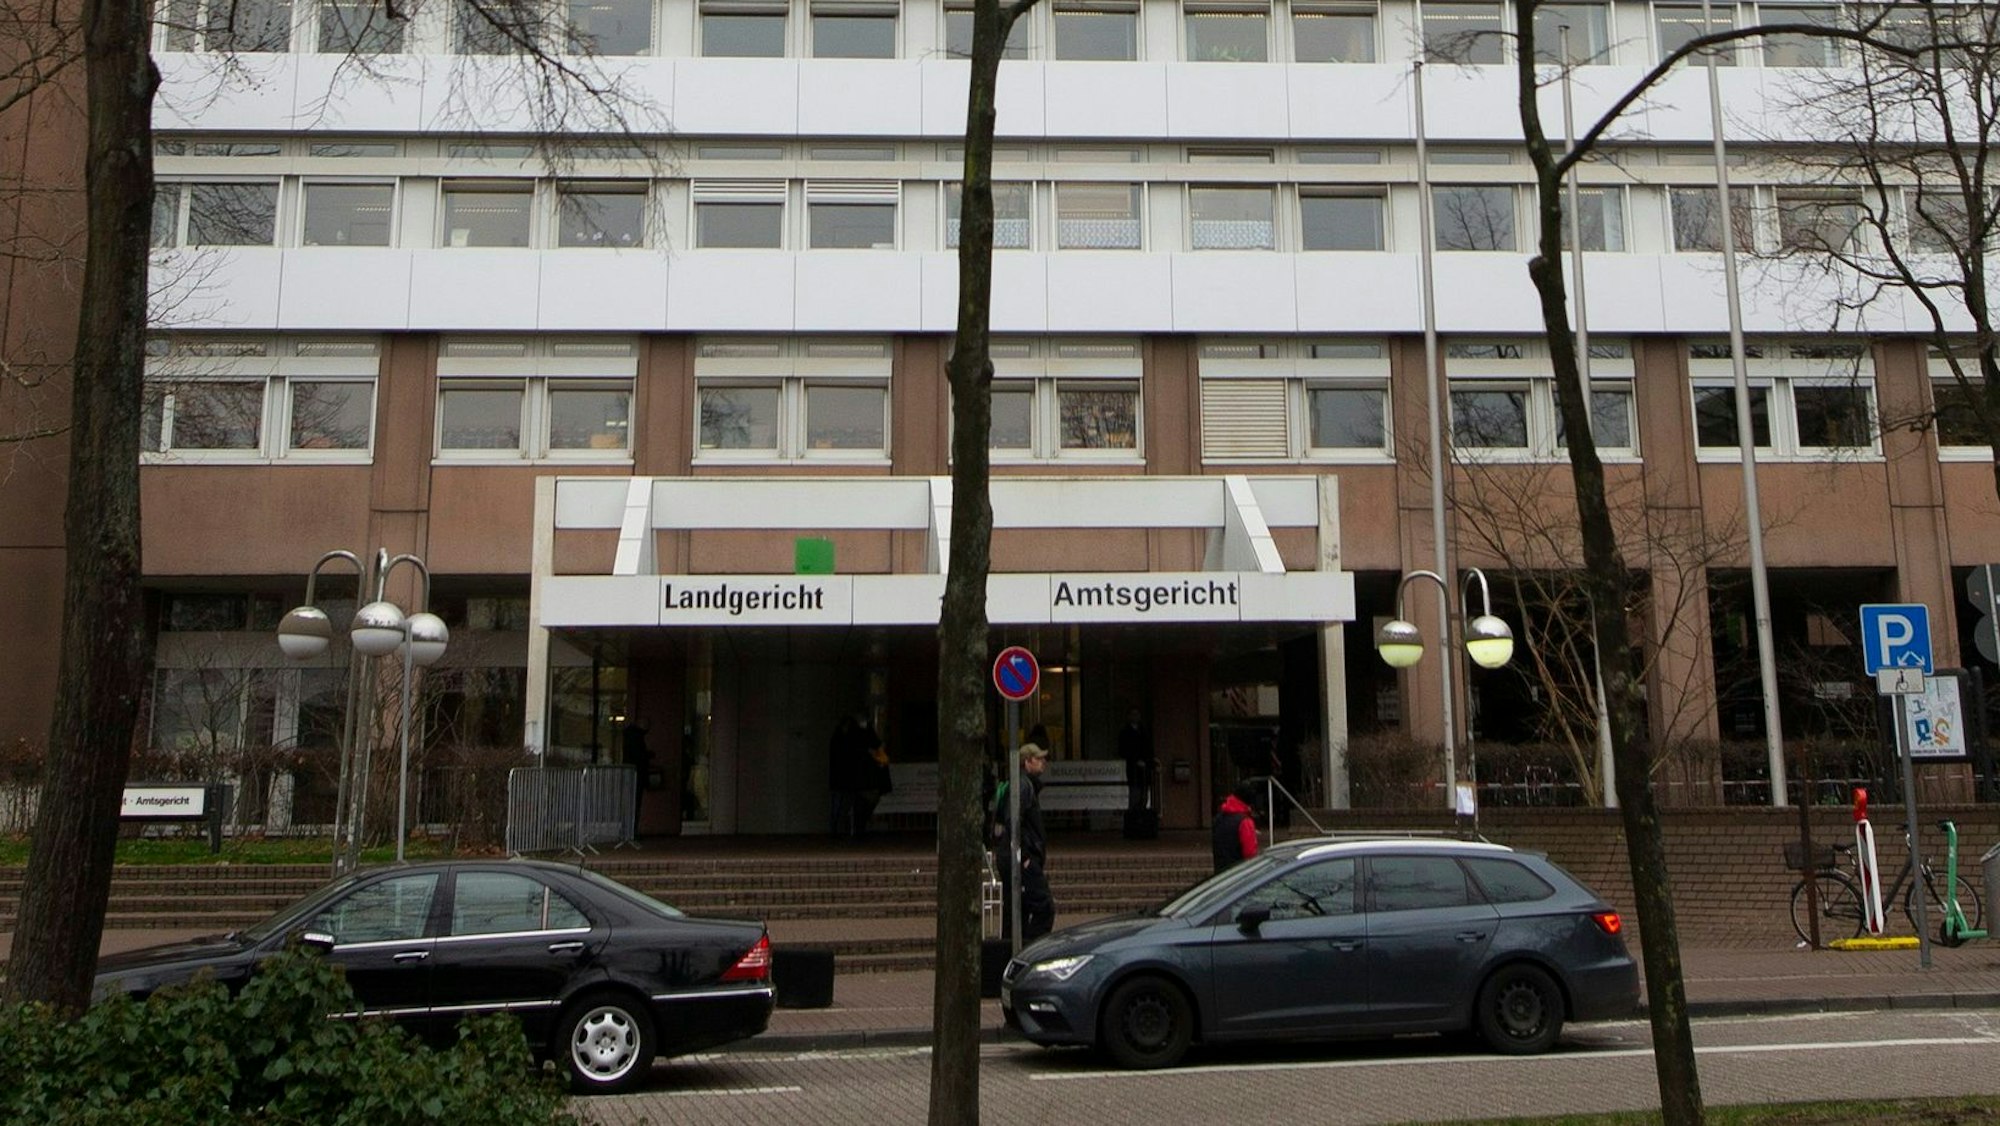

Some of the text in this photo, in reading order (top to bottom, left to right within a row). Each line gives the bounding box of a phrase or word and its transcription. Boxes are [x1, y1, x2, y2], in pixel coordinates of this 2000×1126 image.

[665, 584, 823, 615] Landgericht
[1054, 580, 1237, 612] Amtsgericht
[1878, 614, 1914, 665] P
[136, 796, 190, 807] Amtsgericht
